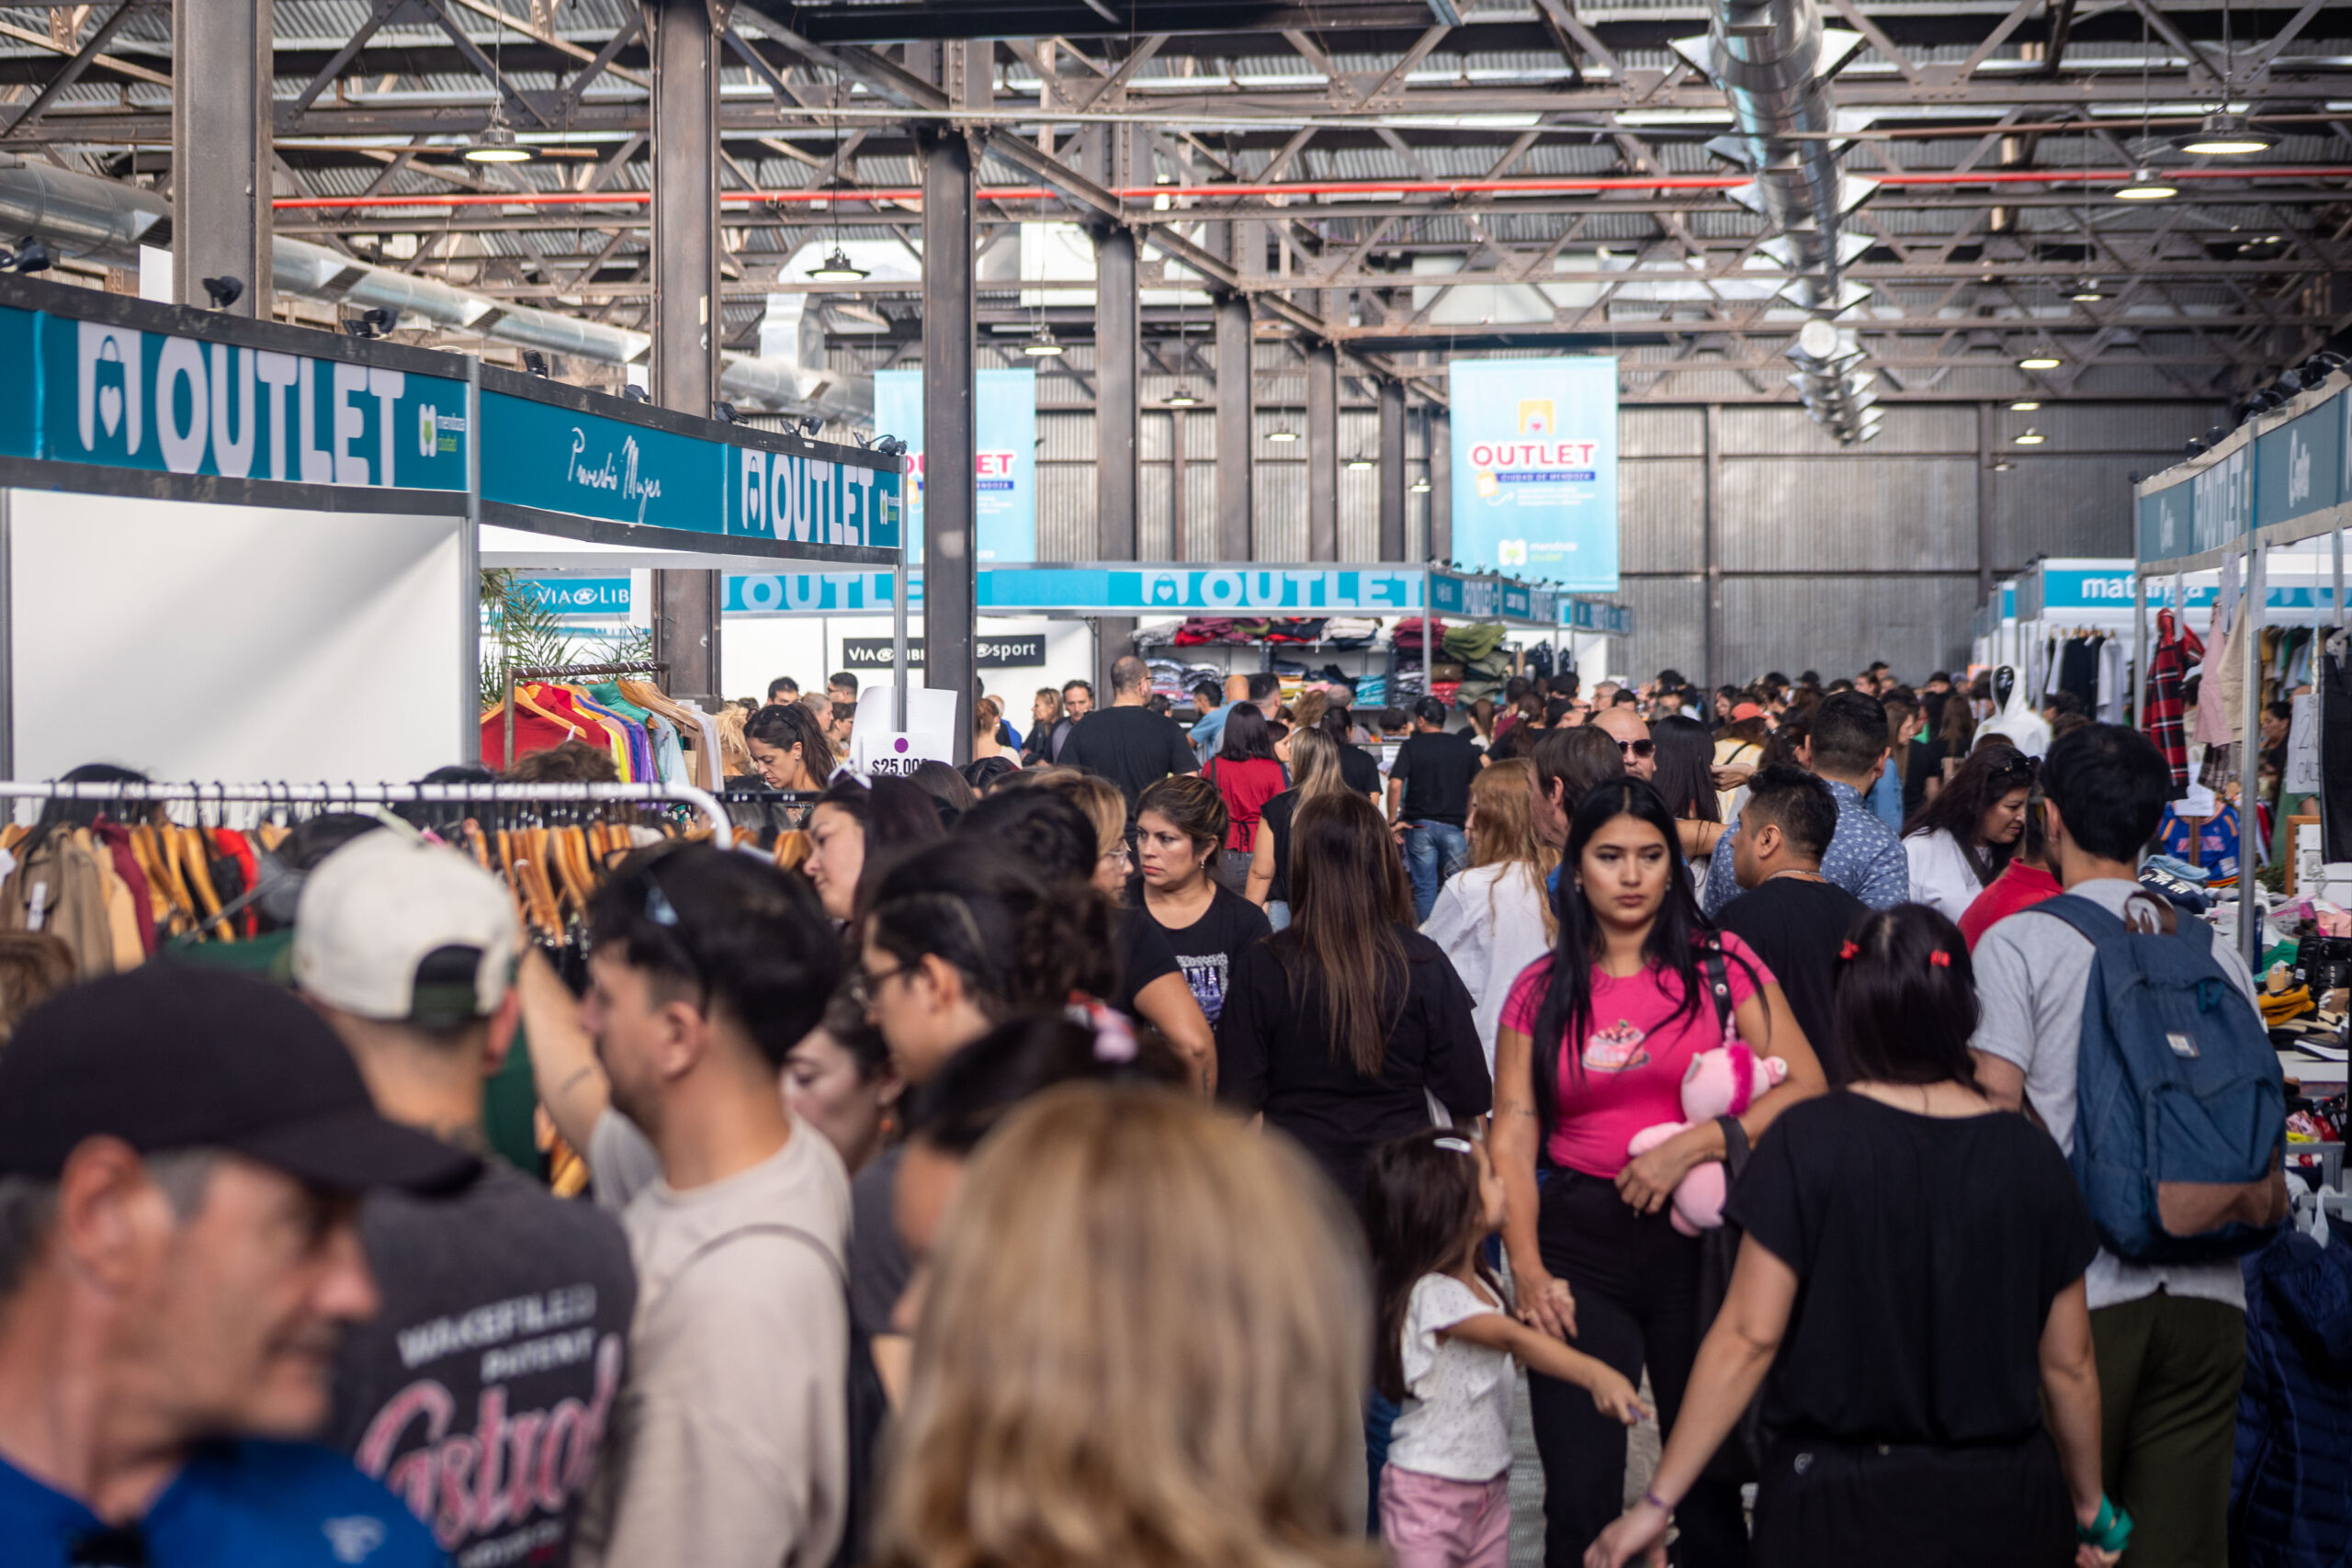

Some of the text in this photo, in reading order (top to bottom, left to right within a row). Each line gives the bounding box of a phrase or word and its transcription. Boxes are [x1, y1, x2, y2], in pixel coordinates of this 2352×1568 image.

[155, 335, 404, 487] OUTLET
[1473, 444, 1595, 466] OUTLET
[771, 453, 874, 547] OUTLET
[537, 586, 629, 605] VIA LIB
[1200, 570, 1422, 607] OUTLET
[848, 643, 1035, 661] VIA sport
[872, 758, 928, 776] $25.00
